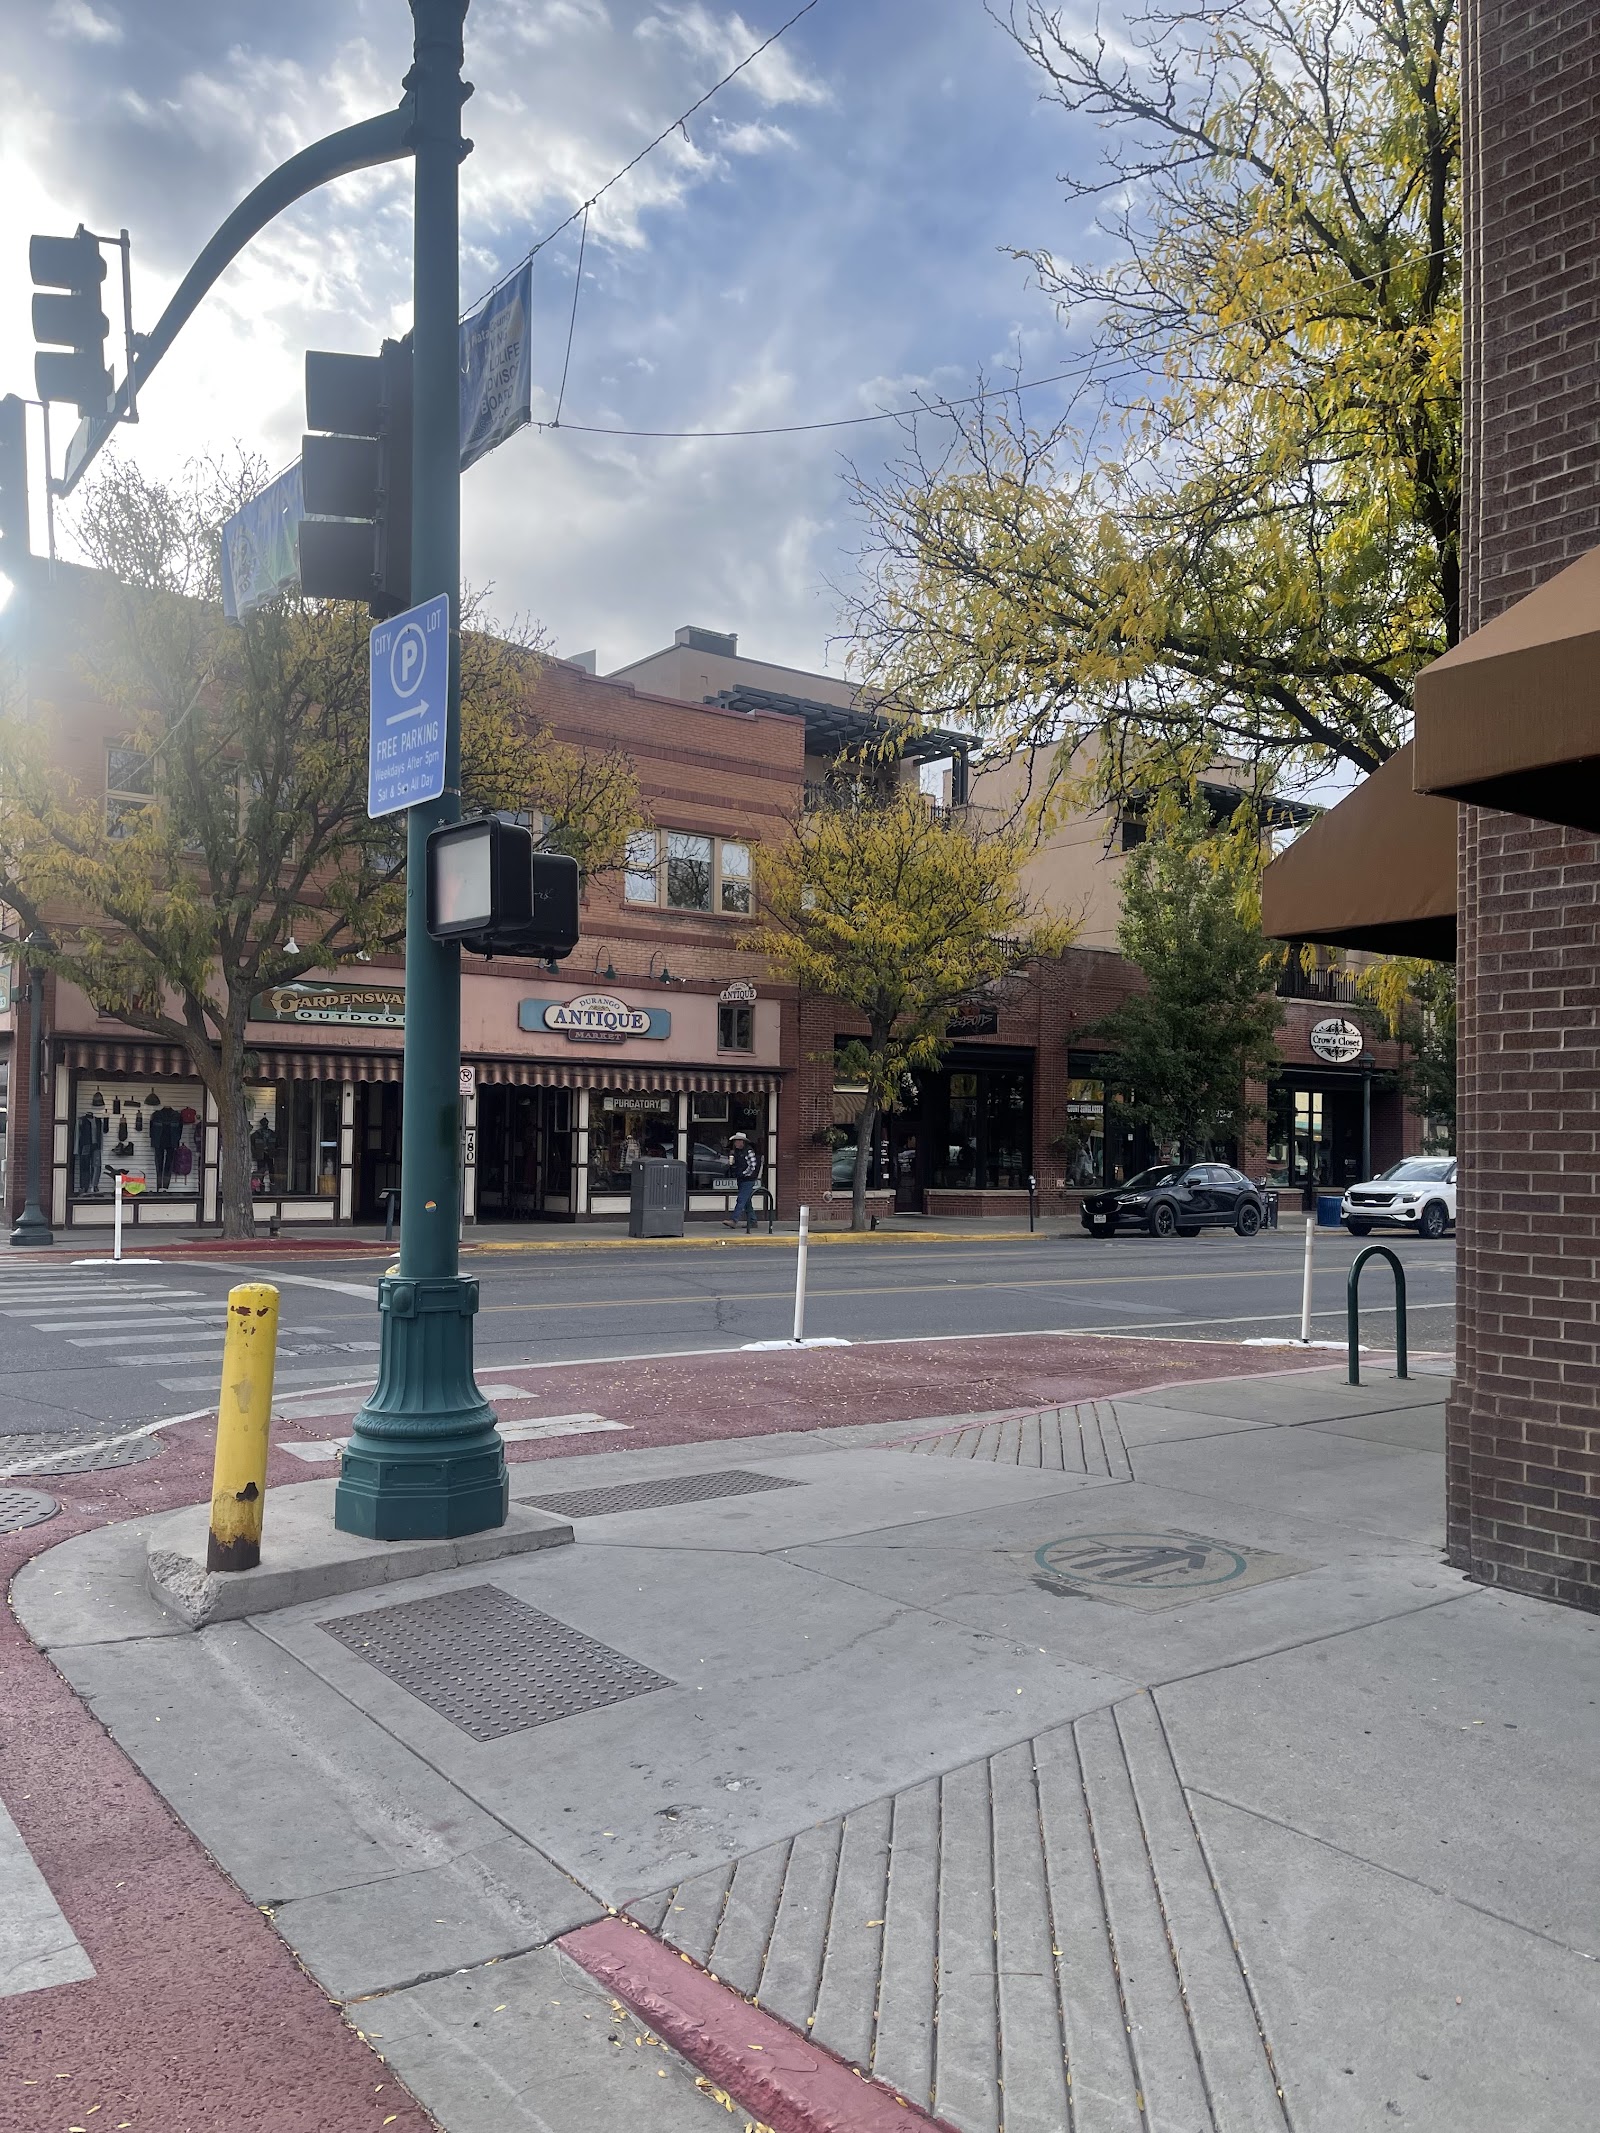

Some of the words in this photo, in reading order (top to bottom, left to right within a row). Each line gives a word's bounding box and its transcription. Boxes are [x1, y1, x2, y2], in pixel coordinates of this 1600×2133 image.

[374, 631, 392, 656] CITY
[426, 609, 442, 633] LOT
[401, 640, 418, 683] P
[376, 735, 398, 762] FREE
[401, 720, 439, 751] PARKING
[375, 760, 405, 782] Weekdays
[407, 756, 423, 772] After
[425, 750, 439, 767] 5pm
[377, 787, 388, 802] Sat
[389, 783, 395, 799] &
[411, 777, 419, 790] All
[420, 773, 434, 789] Day
[579, 997, 621, 1010] DURANGO
[722, 990, 755, 1000] ANTIQUE
[553, 1009, 644, 1030] ANTIQUE
[574, 1031, 622, 1041] MARKET
[1313, 1034, 1336, 1044] Crow's
[1338, 1036, 1360, 1046] Closet
[1166, 1527, 1281, 1556] DISMOUNT
